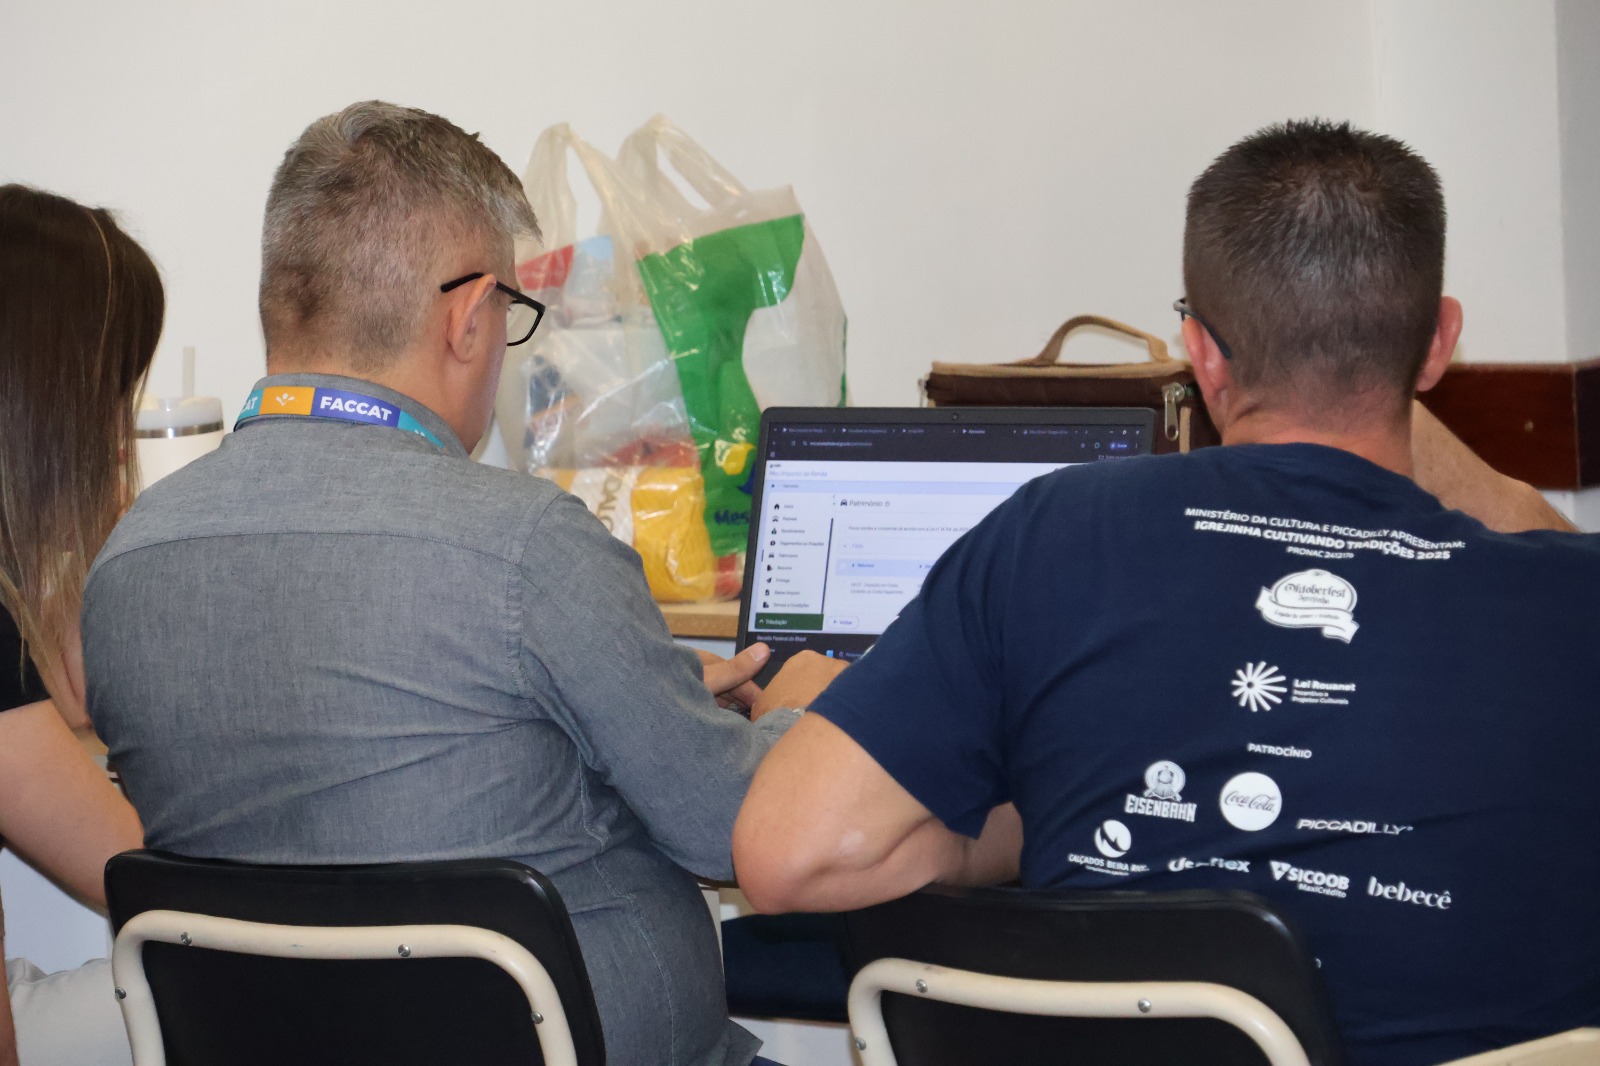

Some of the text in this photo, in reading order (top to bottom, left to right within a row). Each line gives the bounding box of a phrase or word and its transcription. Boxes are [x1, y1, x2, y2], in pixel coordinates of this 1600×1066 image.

[320, 396, 392, 421] FACCAT
[1185, 507, 1466, 549] MINISTÉRIO DA CULTURA E PICCADILLY APRESENTAM:
[1194, 520, 1451, 560] IGREJINHA CULTIVANDO TRADIÇÕES 2025
[1286, 546, 1323, 558] PRONAC
[1284, 583, 1346, 598] Oktoberfest
[1294, 679, 1356, 692] Lei Rouanet
[1247, 743, 1312, 759] PATROCÍNIO
[1125, 794, 1197, 822] EISENBAHN
[1068, 853, 1105, 867] CALÇADOS
[1106, 859, 1130, 872] BEIRA
[1287, 867, 1349, 891] SICOOB
[1298, 883, 1347, 899] MaxiCrédito
[1368, 876, 1451, 910] bebecê
